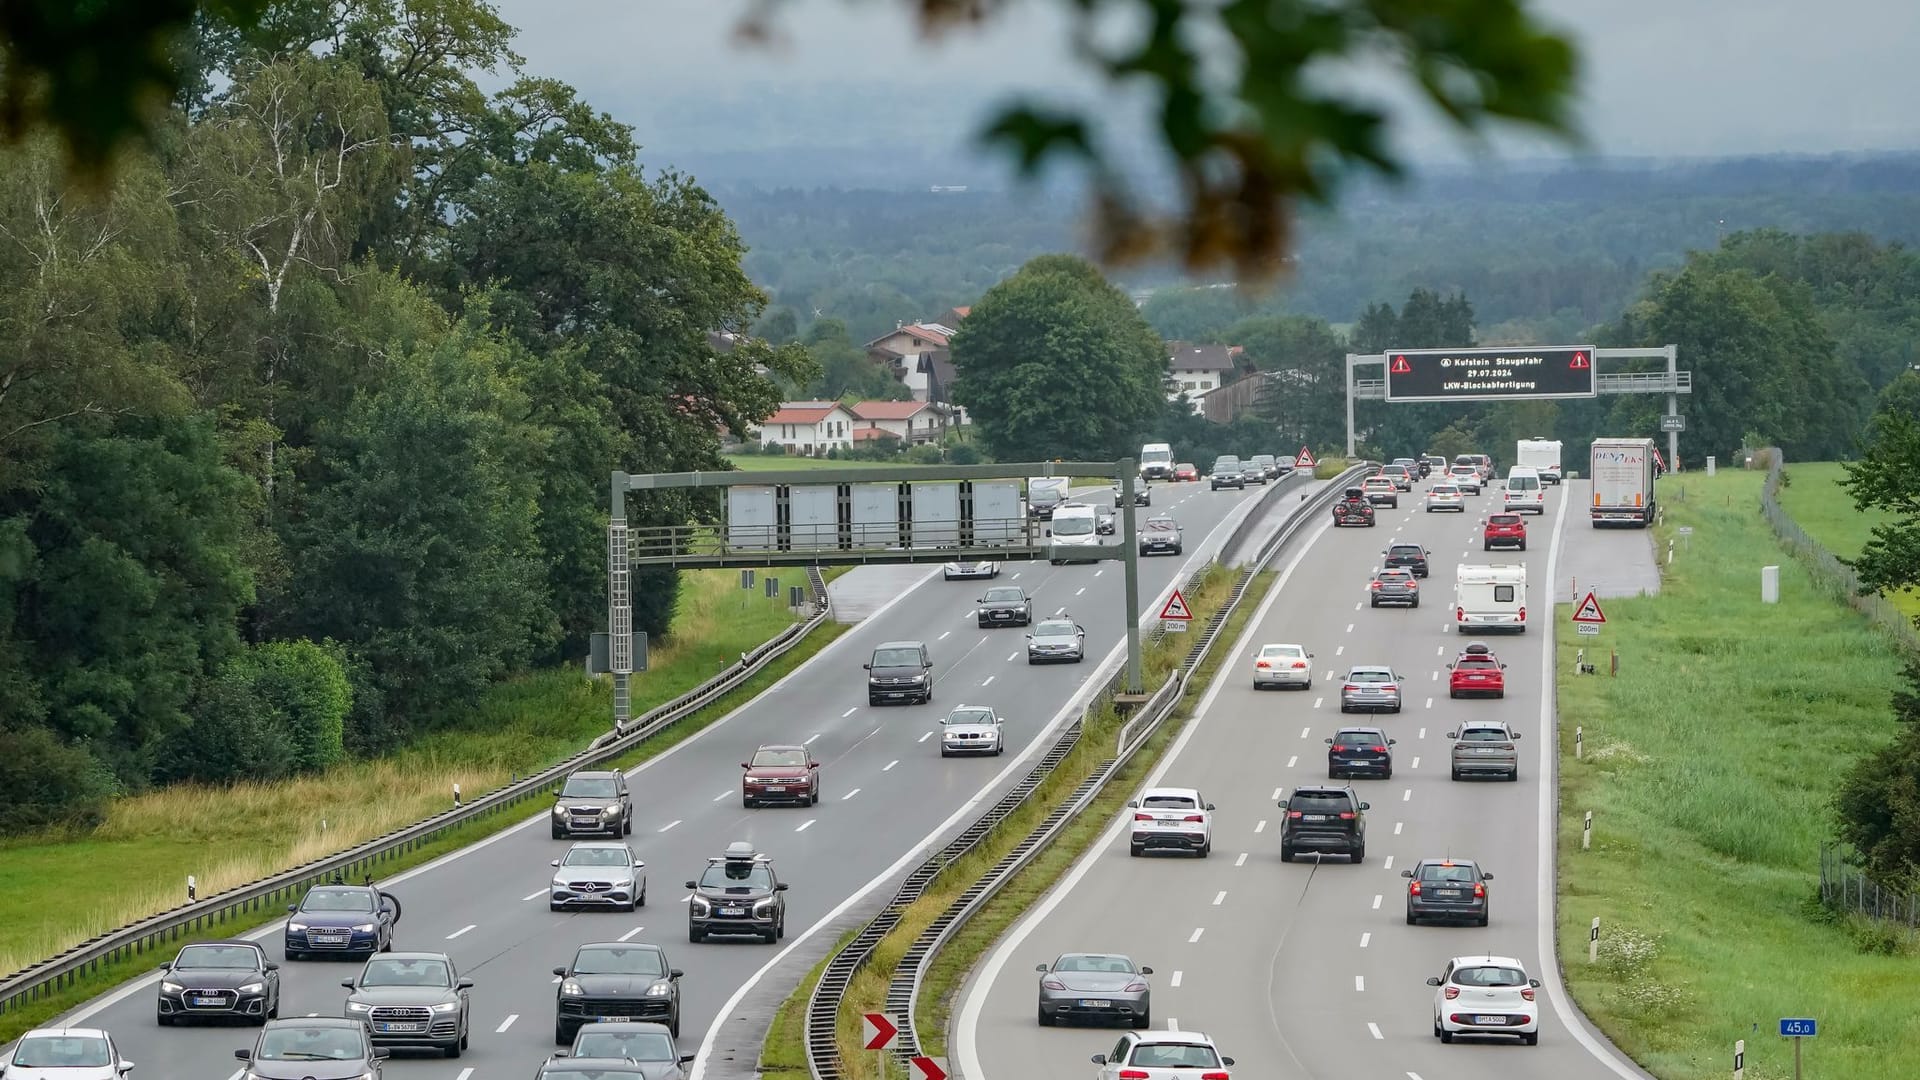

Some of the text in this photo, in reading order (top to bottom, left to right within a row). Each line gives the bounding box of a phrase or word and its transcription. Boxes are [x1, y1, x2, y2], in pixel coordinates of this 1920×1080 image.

[1454, 358, 1490, 366] Kufstein
[1496, 357, 1543, 367] Staugefahr
[1467, 370, 1512, 378] 29.07.2024
[1443, 381, 1536, 390] LKW-Blockabfertigung
[1786, 1021, 1810, 1034] 45.0
